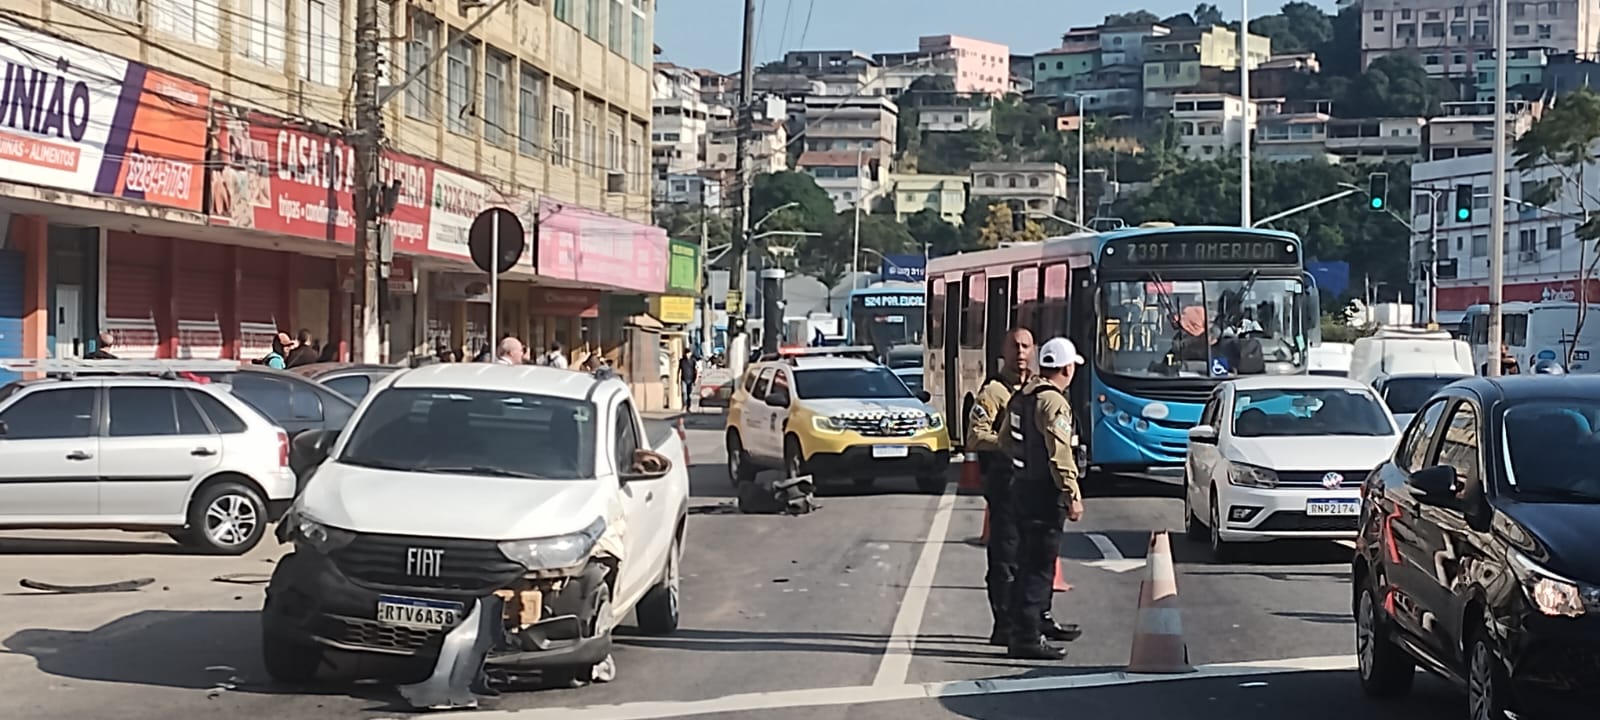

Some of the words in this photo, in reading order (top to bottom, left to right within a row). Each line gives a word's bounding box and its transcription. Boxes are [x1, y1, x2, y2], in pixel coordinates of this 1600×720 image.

[29, 143, 76, 168] ALIMENTOS
[277, 130, 319, 187] CASA
[322, 141, 342, 192] DO
[278, 192, 301, 225] tripas
[1194, 242, 1275, 258] AMERICA
[864, 296, 881, 307] 524
[406, 547, 445, 577] FIAT
[385, 605, 454, 625] RTV6A38
